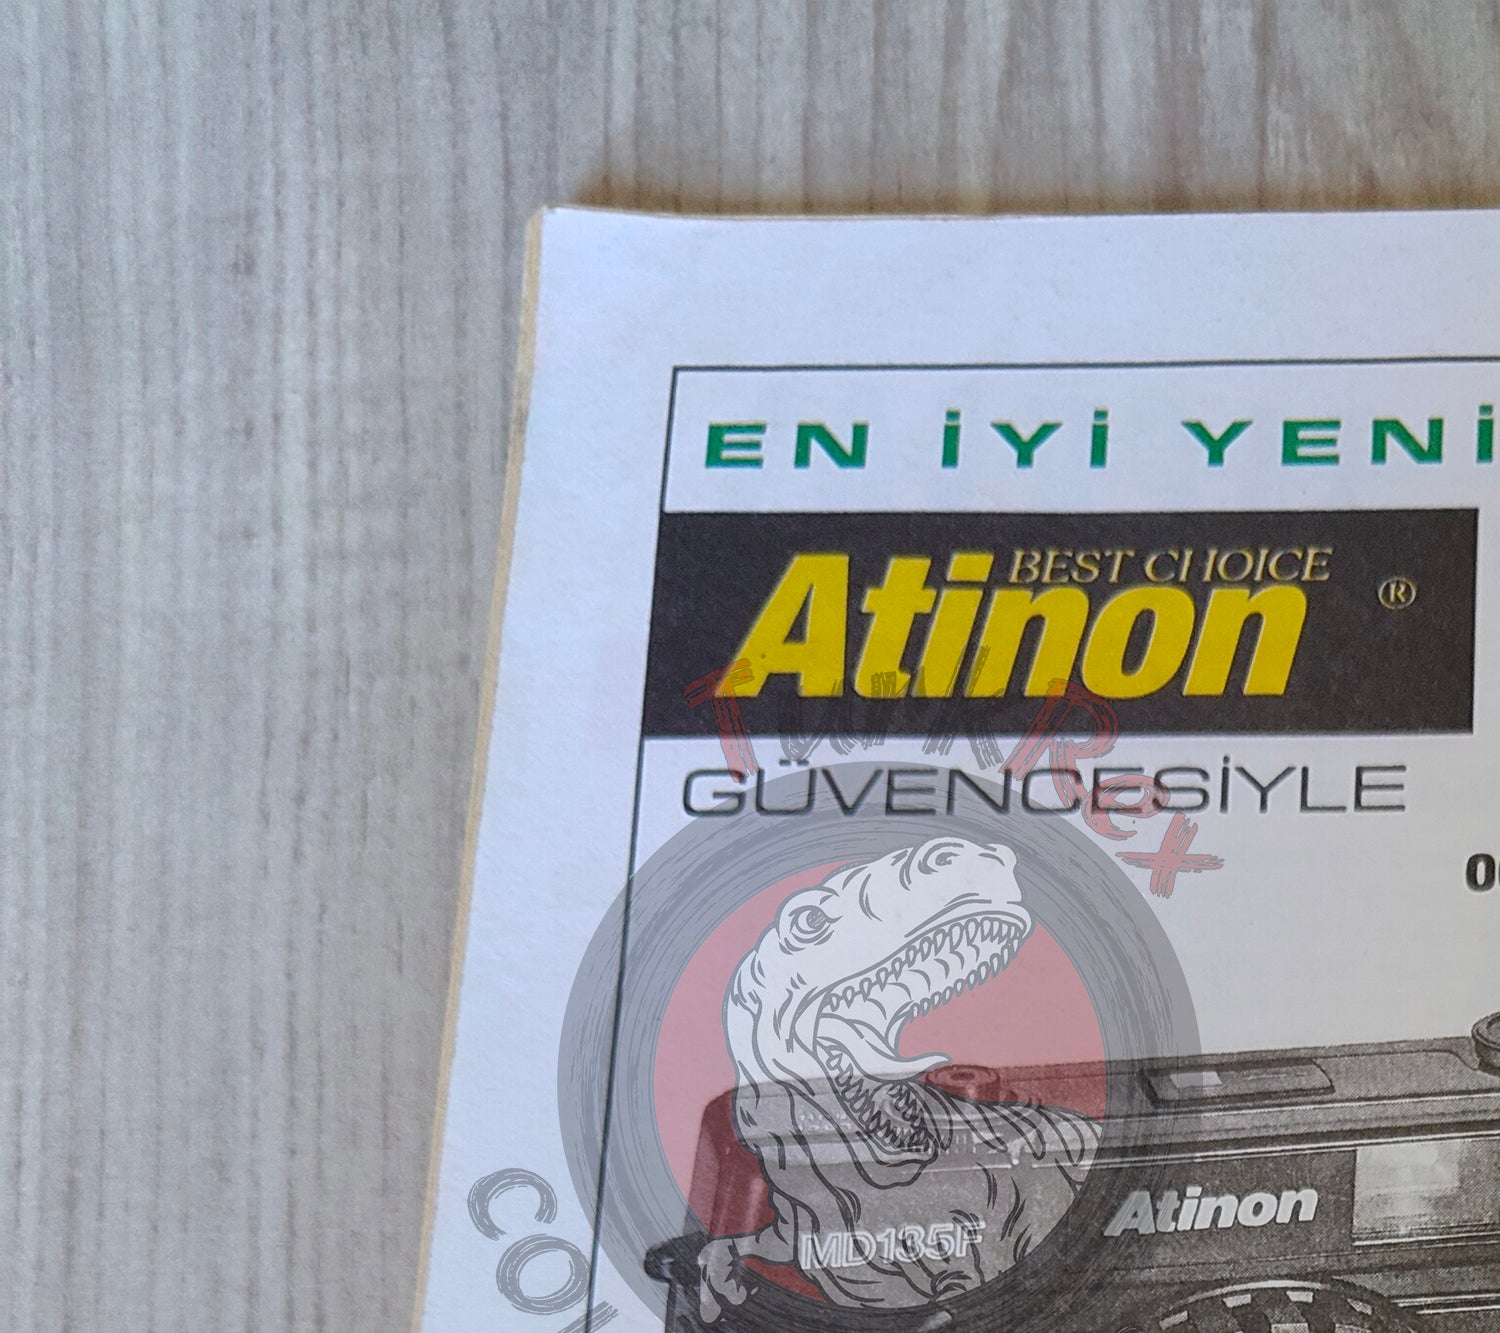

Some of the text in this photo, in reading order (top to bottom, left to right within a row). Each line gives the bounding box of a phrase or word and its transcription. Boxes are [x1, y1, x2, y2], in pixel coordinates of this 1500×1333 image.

[704, 422, 870, 469] EN
[941, 409, 1109, 468] İYİ
[1182, 405, 1496, 468] YENİ
[1009, 547, 1333, 583] BEST CHOICE
[715, 553, 1307, 698] Atinon
[682, 756, 1408, 818] GÜVENCESİYLE
[1103, 1186, 1319, 1241] Atinon
